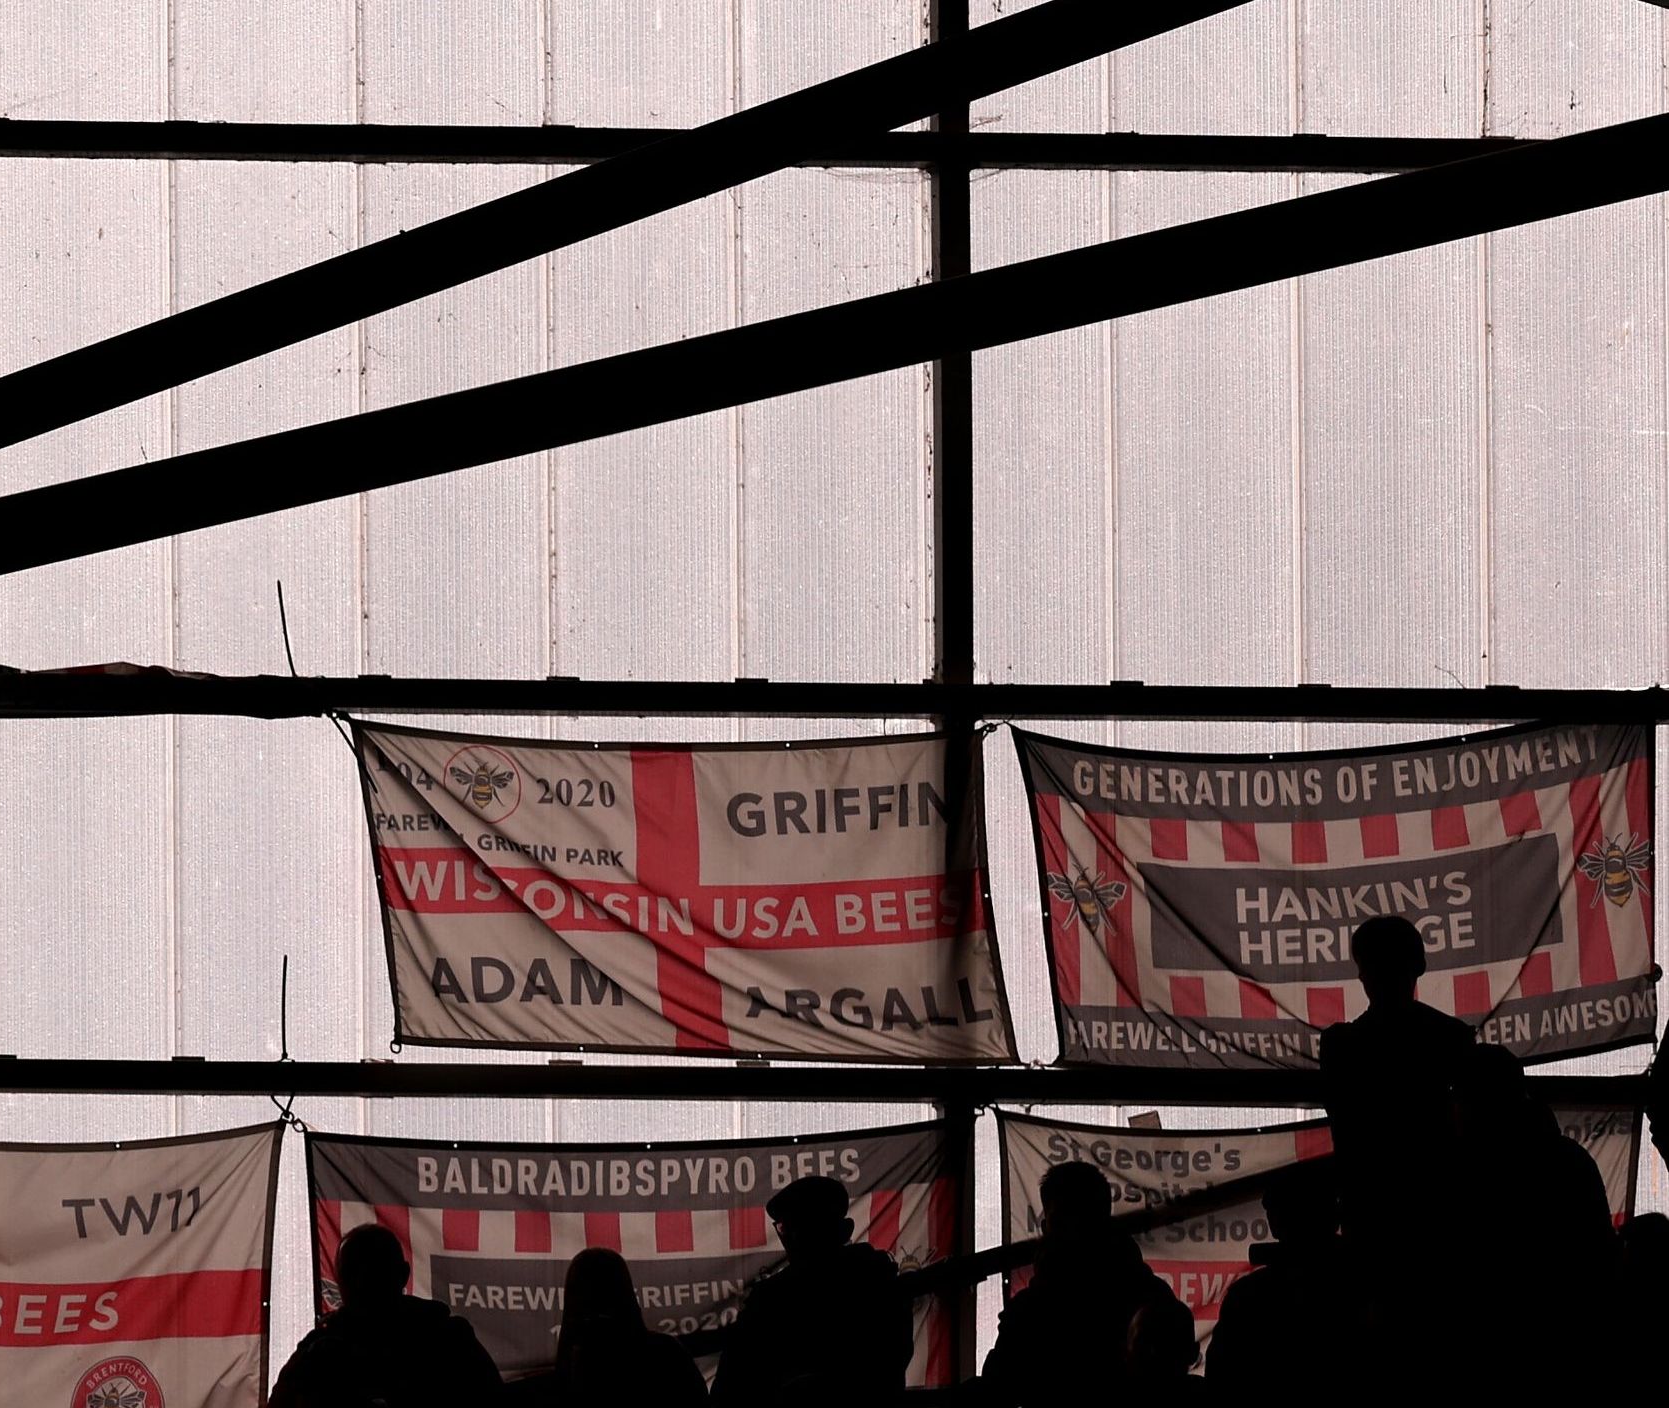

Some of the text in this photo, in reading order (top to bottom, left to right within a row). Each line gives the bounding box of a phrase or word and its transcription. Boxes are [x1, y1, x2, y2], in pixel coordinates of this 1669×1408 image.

[1073, 726, 1599, 808] GENERATIONS OF ENJOYMENT
[536, 778, 616, 807] 2020
[566, 848, 624, 867] PARK
[711, 896, 819, 940] USA
[834, 885, 961, 935] BEES
[1236, 871, 1472, 924] HANKIN'S
[1239, 911, 1476, 965] HERIGE
[431, 956, 624, 1006] ADAM
[746, 977, 994, 1032] ARGALL
[417, 1155, 756, 1198] BALDRADIBSPYRO
[1047, 1134, 1242, 1178] St George's
[634, 1278, 745, 1309] RIFFIN
[87, 1363, 147, 1390] BRENTFORD
